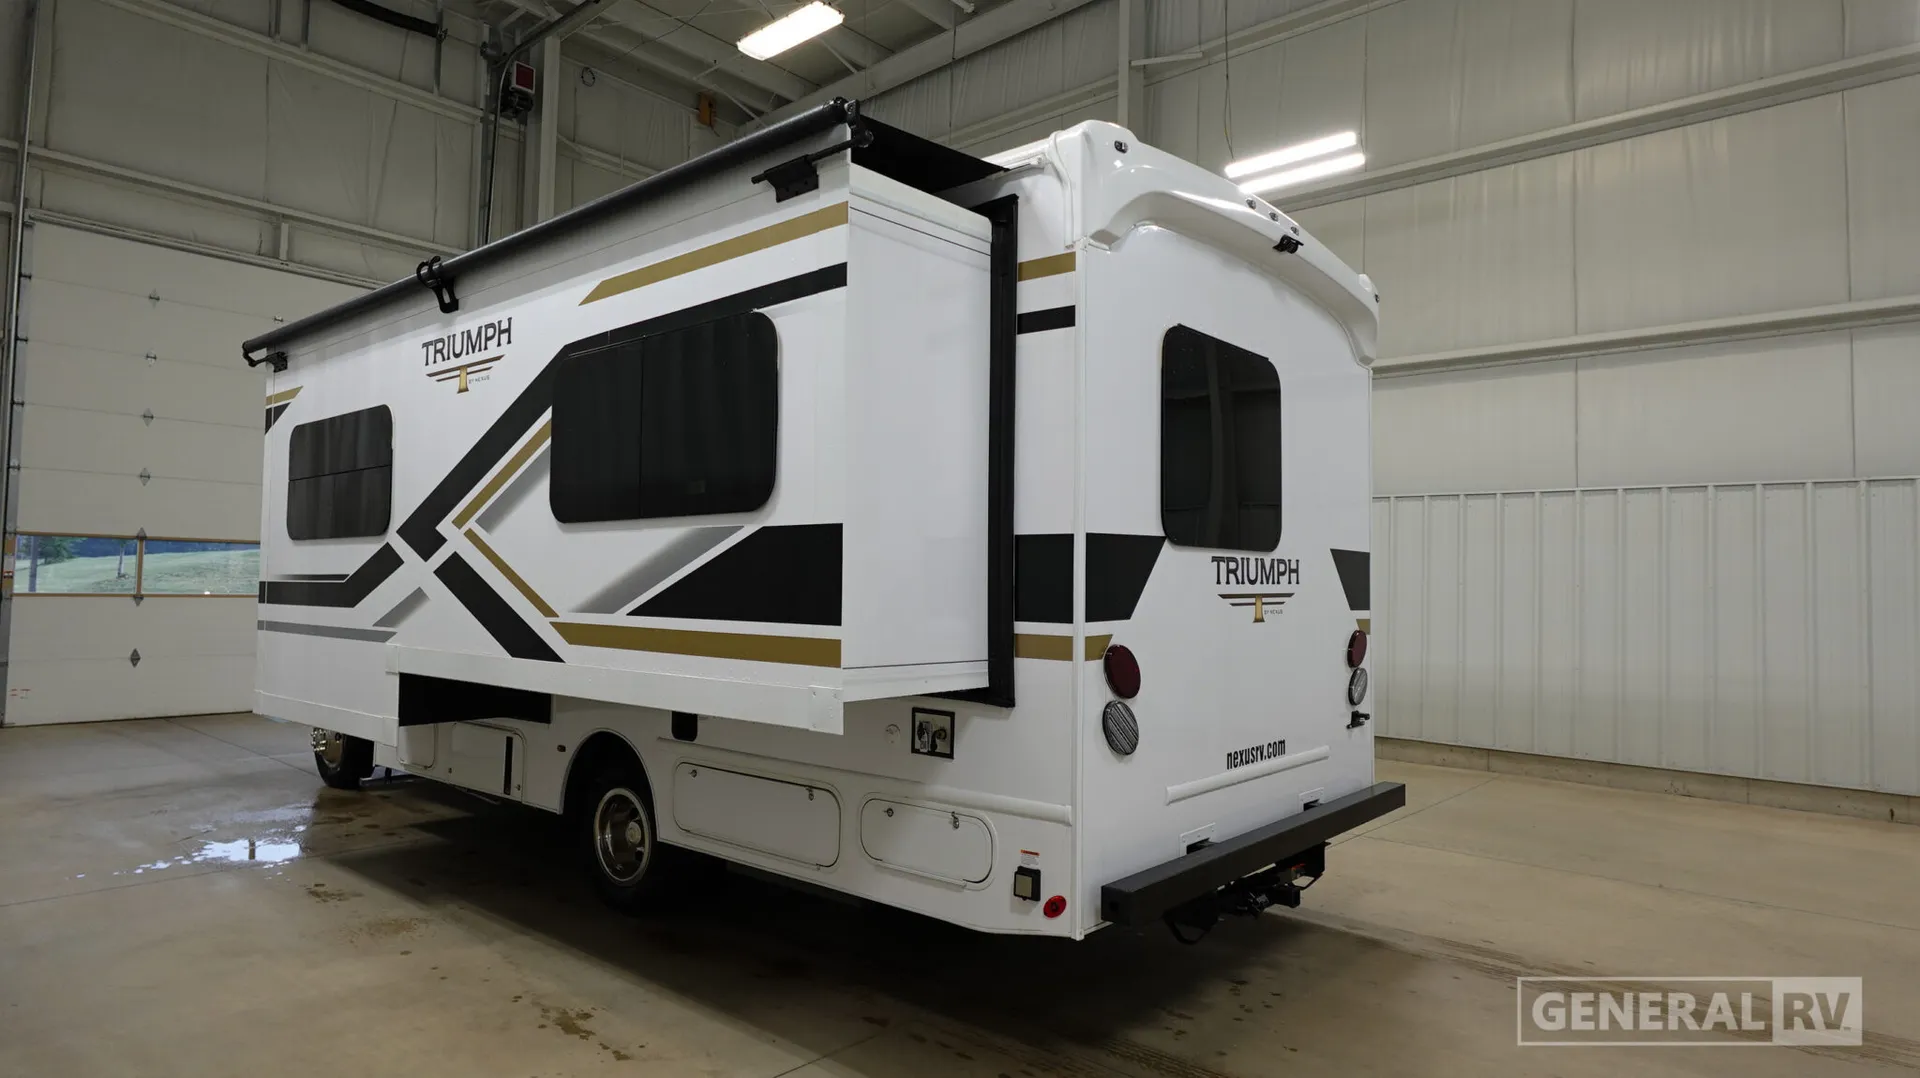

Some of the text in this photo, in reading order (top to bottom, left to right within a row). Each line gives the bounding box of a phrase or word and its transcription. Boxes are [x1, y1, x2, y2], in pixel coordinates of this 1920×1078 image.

[421, 316, 513, 367] TRIUMPH
[1211, 555, 1300, 586] TRIUMPH
[1226, 739, 1286, 770] nexusrv.com
